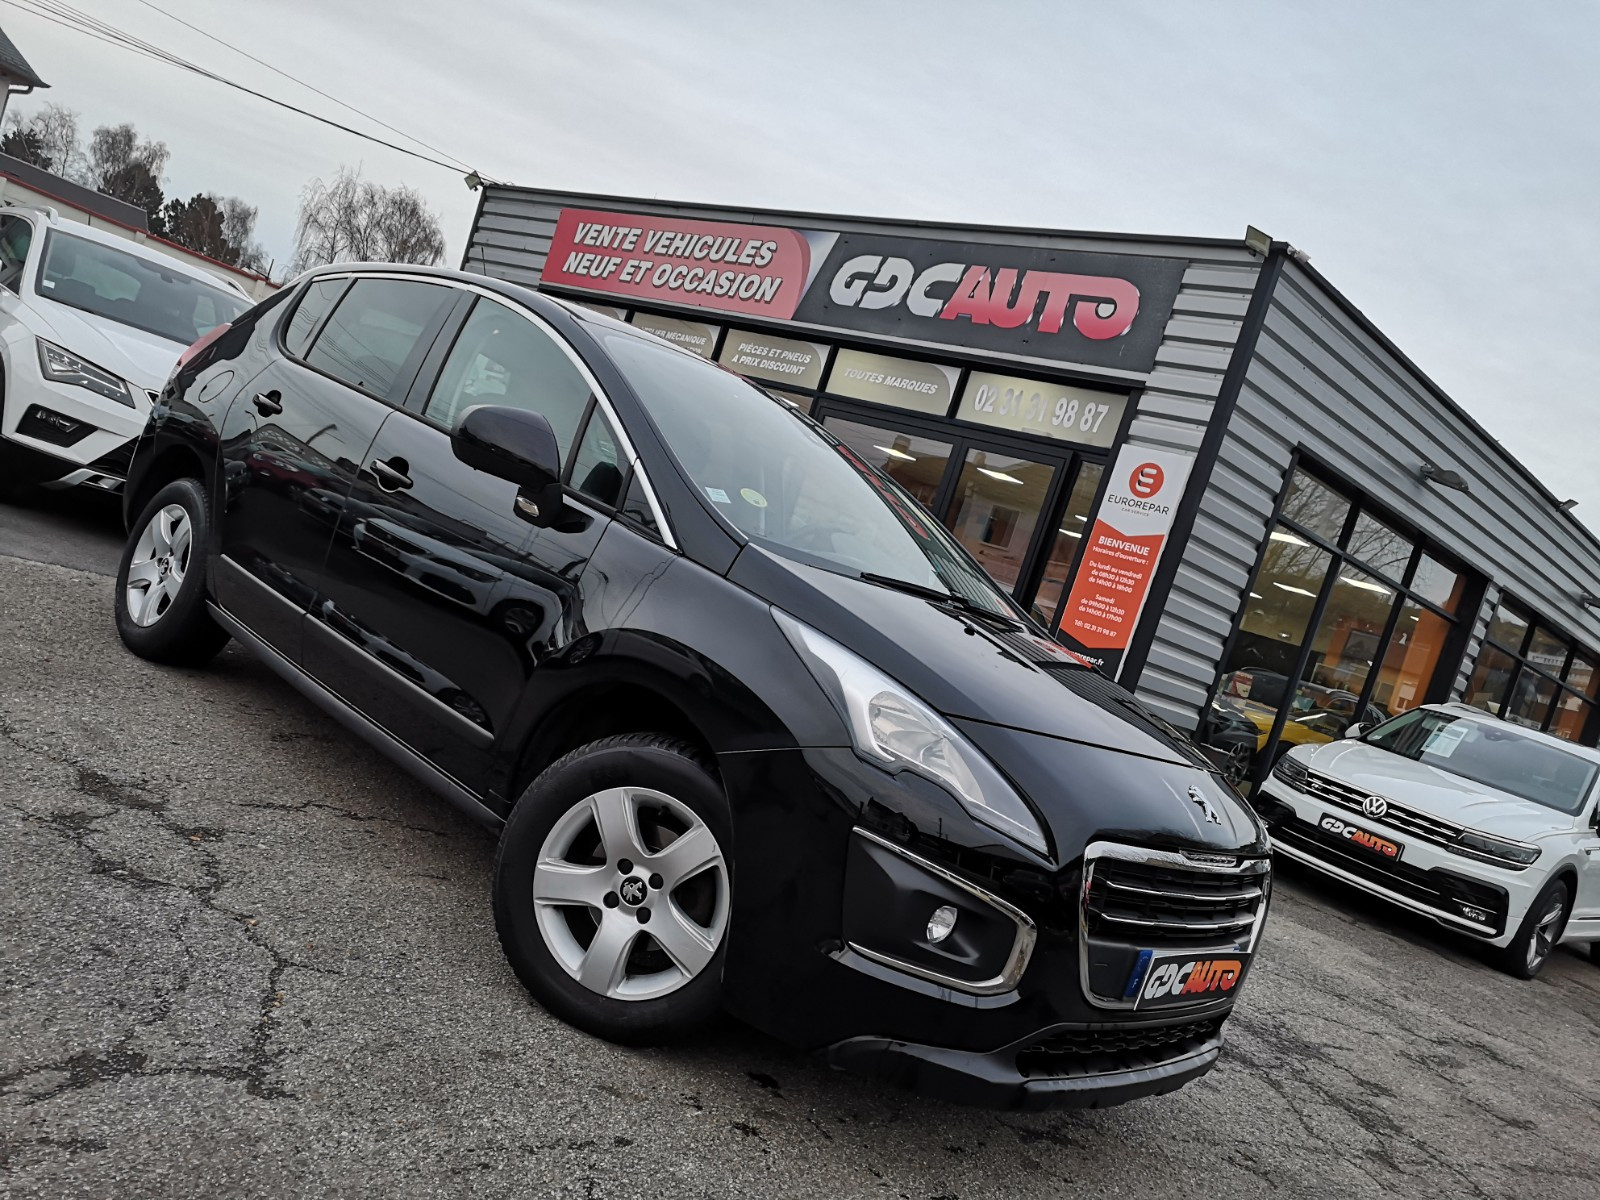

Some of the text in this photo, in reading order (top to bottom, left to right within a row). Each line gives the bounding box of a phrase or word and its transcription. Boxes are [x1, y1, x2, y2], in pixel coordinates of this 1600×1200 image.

[573, 222, 777, 267] VENTE VEHICULES
[561, 251, 783, 303] NEUF ET OCCASION
[738, 355, 761, 367] PRIX
[760, 359, 805, 375] DISCOUNT
[768, 348, 782, 358] ET
[780, 350, 812, 364] PNEUS
[843, 366, 939, 395] TOUTES MARQUES
[973, 383, 999, 413] 02
[1052, 397, 1080, 429] 98
[1079, 401, 1110, 434] 87
[1107, 494, 1170, 516] EUROREPAR
[1092, 545, 1115, 557] Horaires
[1098, 535, 1150, 556] BIENVENUE
[1097, 562, 1111, 571] lundi
[1118, 569, 1143, 580] vendredi
[1095, 594, 1116, 604] Samedi
